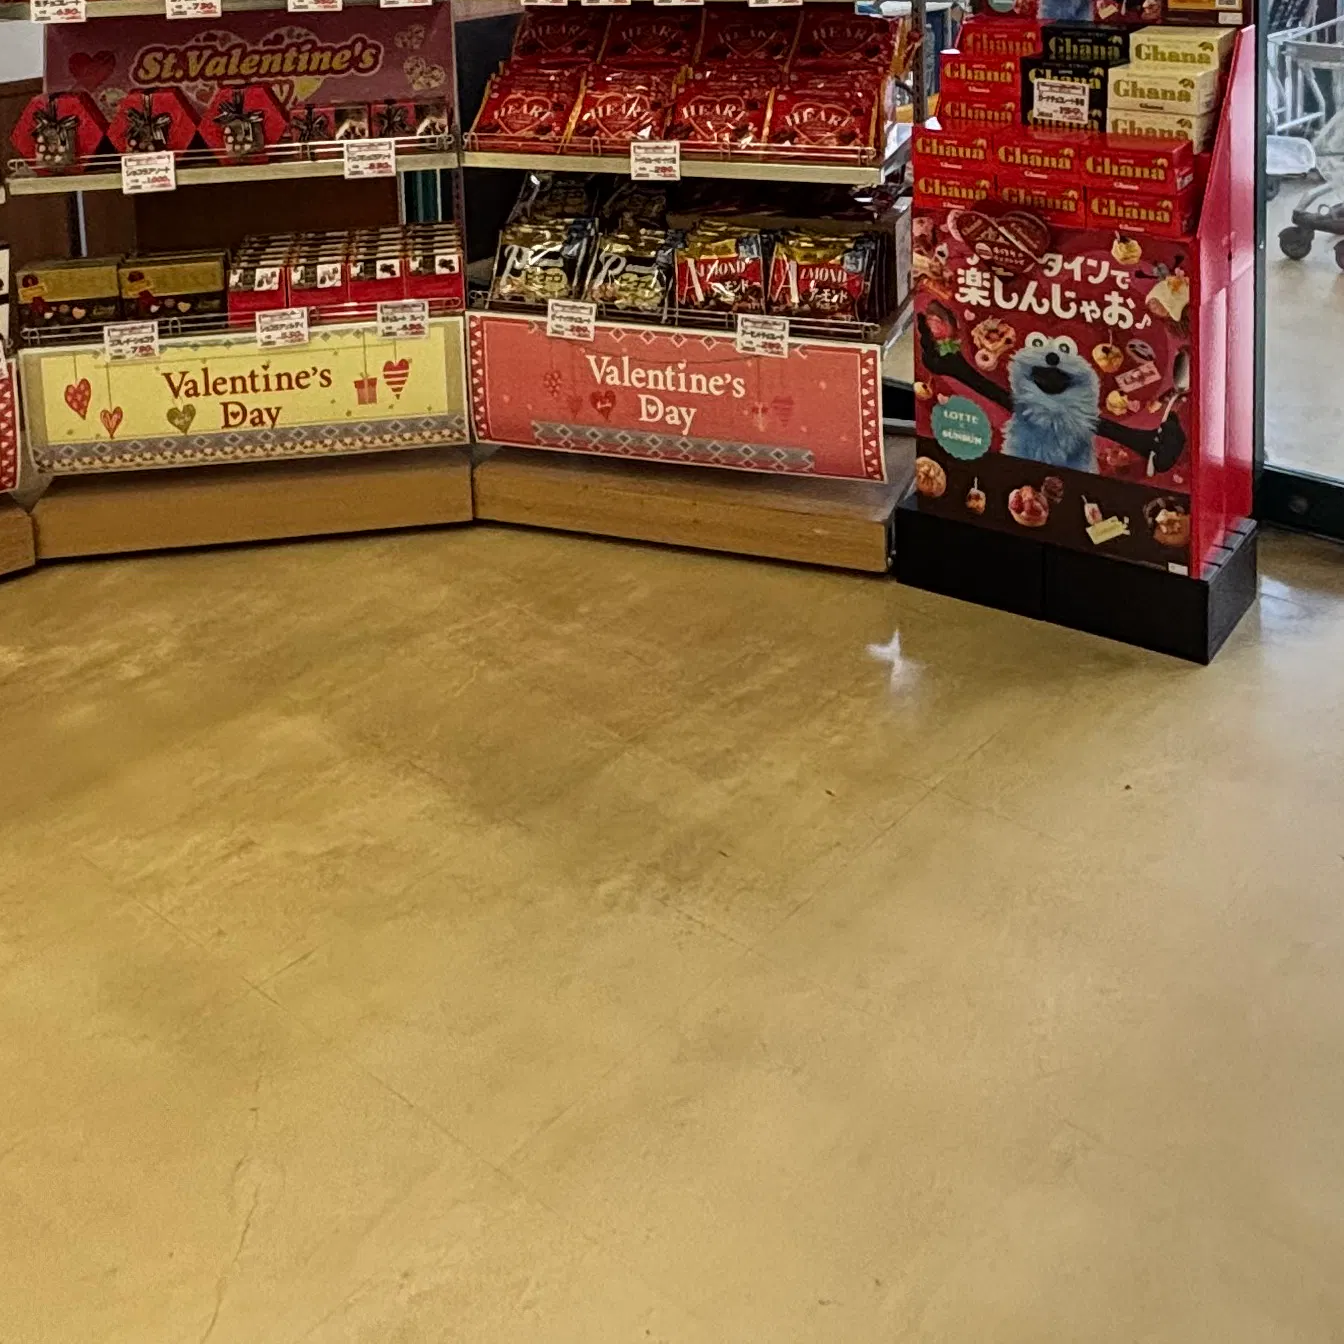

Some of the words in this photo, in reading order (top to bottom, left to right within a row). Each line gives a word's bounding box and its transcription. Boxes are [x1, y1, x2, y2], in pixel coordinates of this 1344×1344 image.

[1134, 42, 1212, 65] Ghana
[943, 61, 1013, 83] Ghana
[1112, 79, 1192, 103] Ghana
[495, 99, 554, 122] HEART
[682, 101, 747, 124] HEART
[785, 107, 856, 128] HEART
[944, 100, 1014, 122] Ghana
[915, 136, 986, 160] Ghana
[998, 145, 1072, 170] Ghana
[1085, 156, 1167, 181] Ghana
[919, 177, 988, 201] Ghana
[1002, 187, 1077, 213] Ghana
[1091, 197, 1171, 224] Ghana
[162, 360, 333, 400] Valentine's
[586, 354, 747, 399] Valentine's
[221, 401, 282, 431] Day
[639, 394, 697, 436] Day
[943, 410, 979, 425] LOTTE
